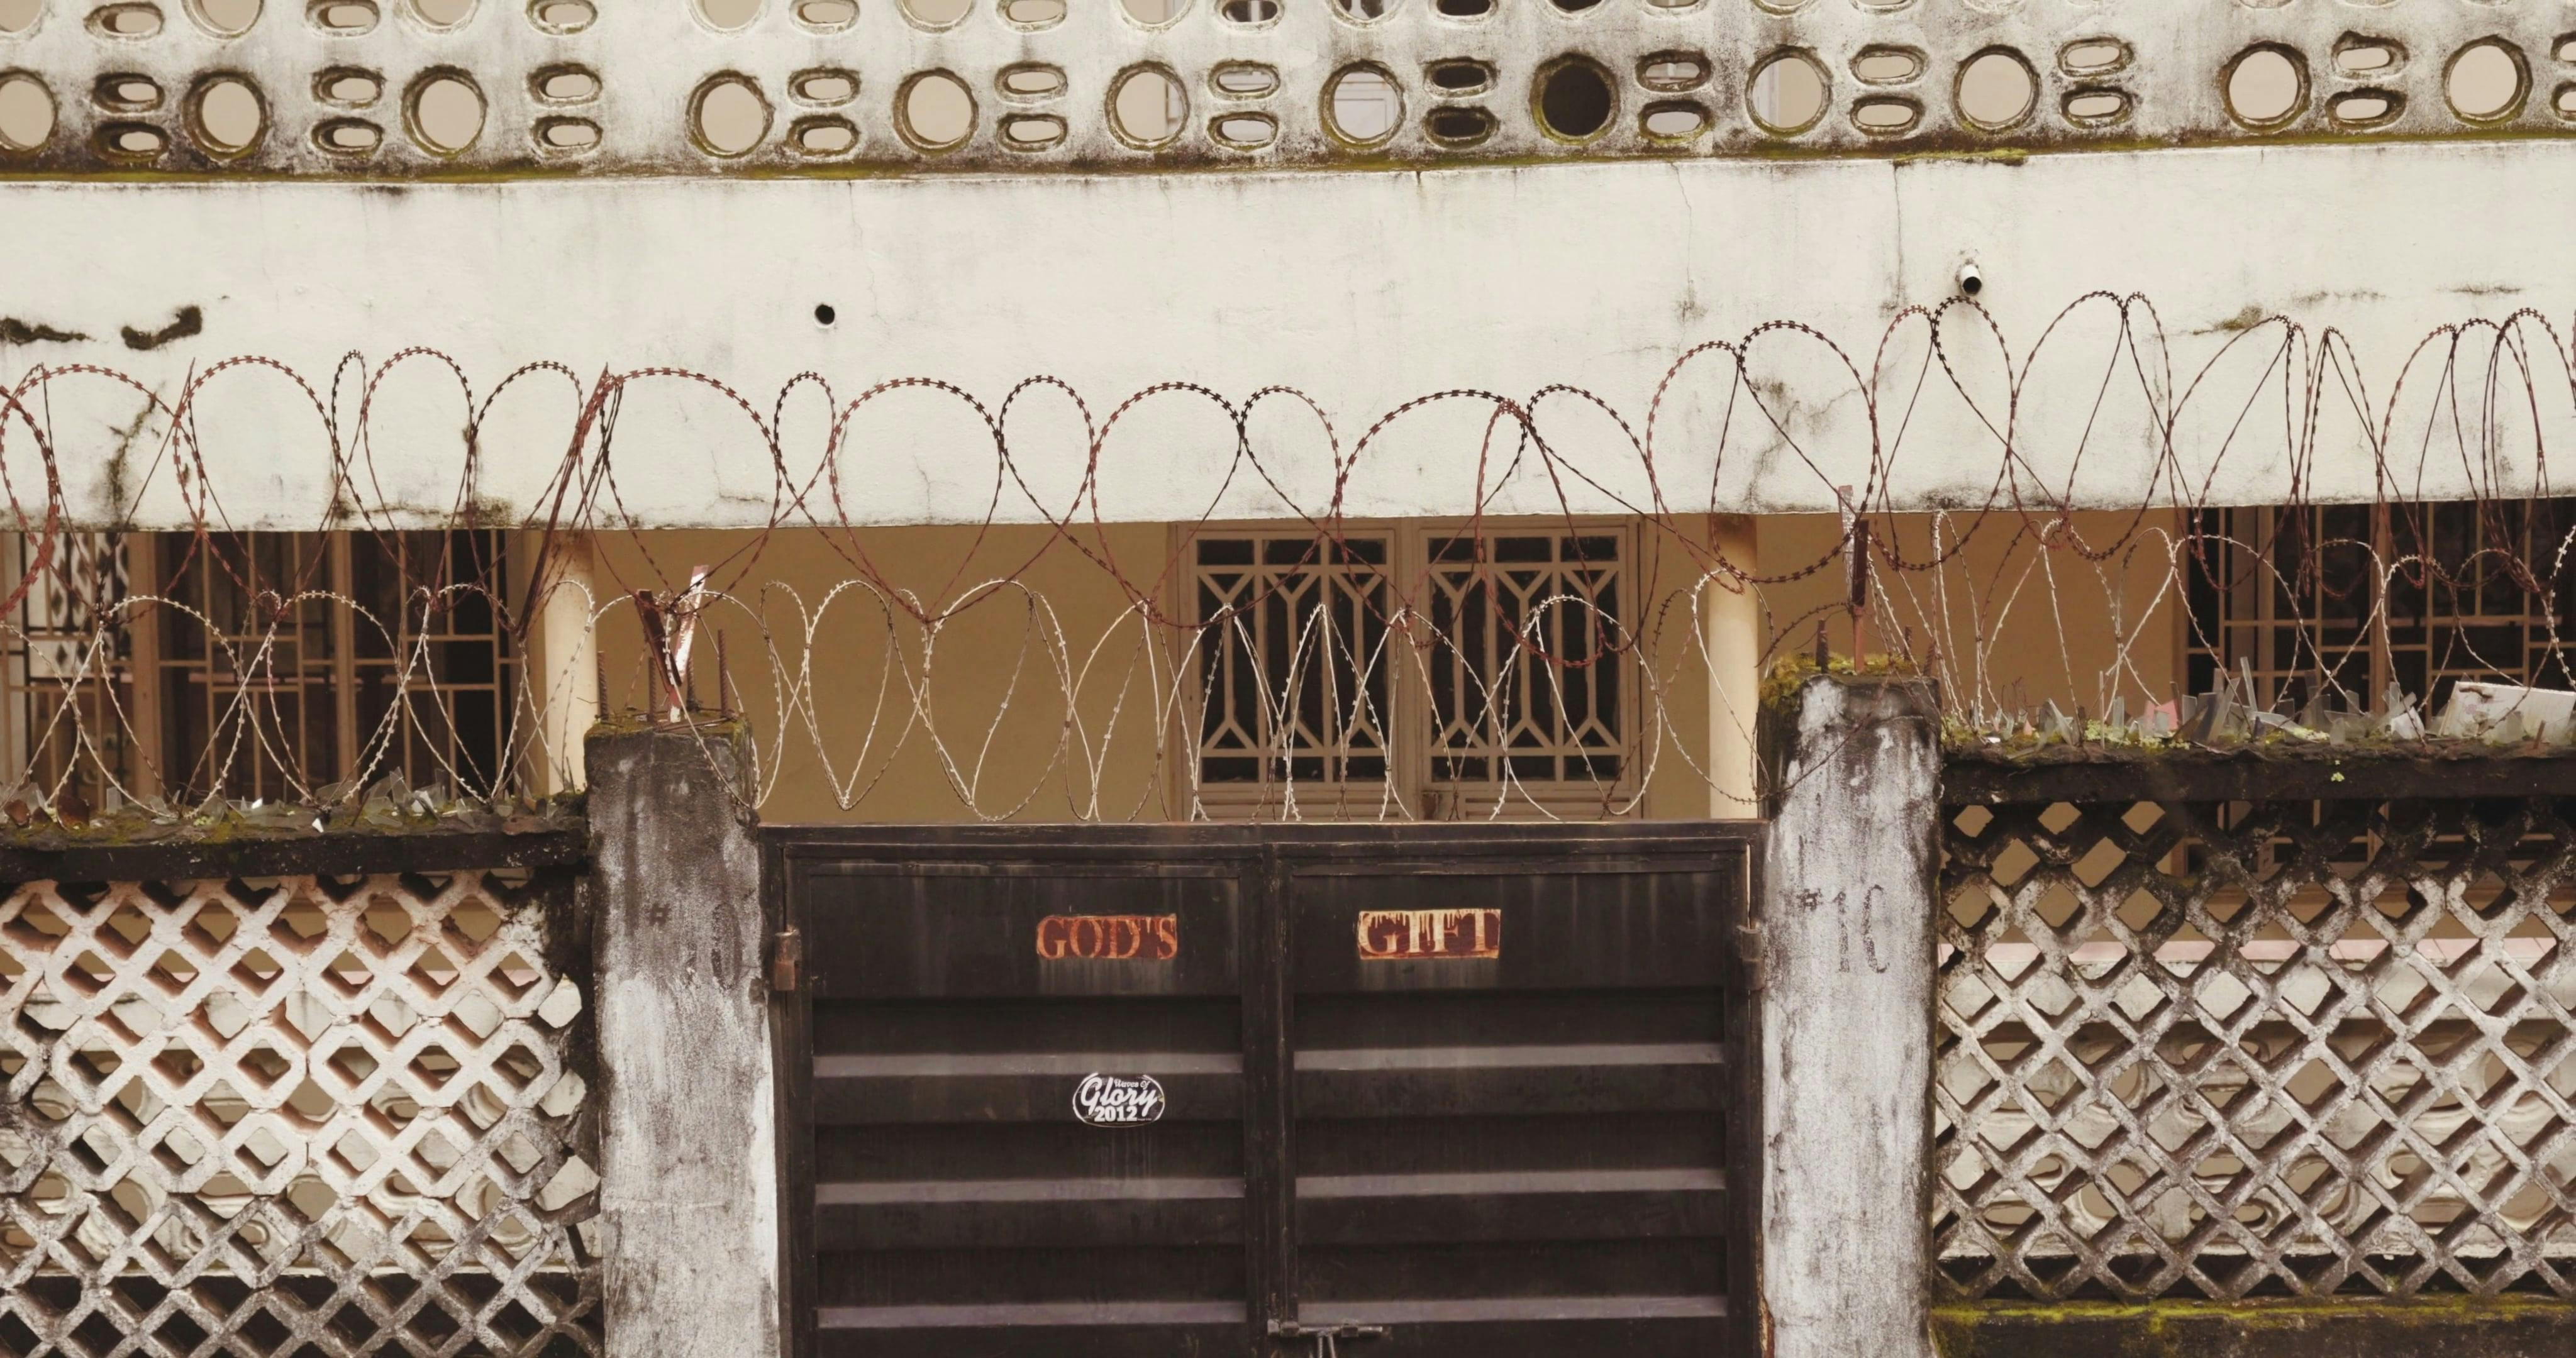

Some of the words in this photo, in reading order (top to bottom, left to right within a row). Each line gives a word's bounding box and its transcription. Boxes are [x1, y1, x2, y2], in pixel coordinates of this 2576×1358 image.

[1036, 915, 1178, 959] GOD'S
[1357, 909, 1501, 957] GIFT
[1080, 1076, 1157, 1117] Glory
[1094, 1105, 1138, 1122] 2012
